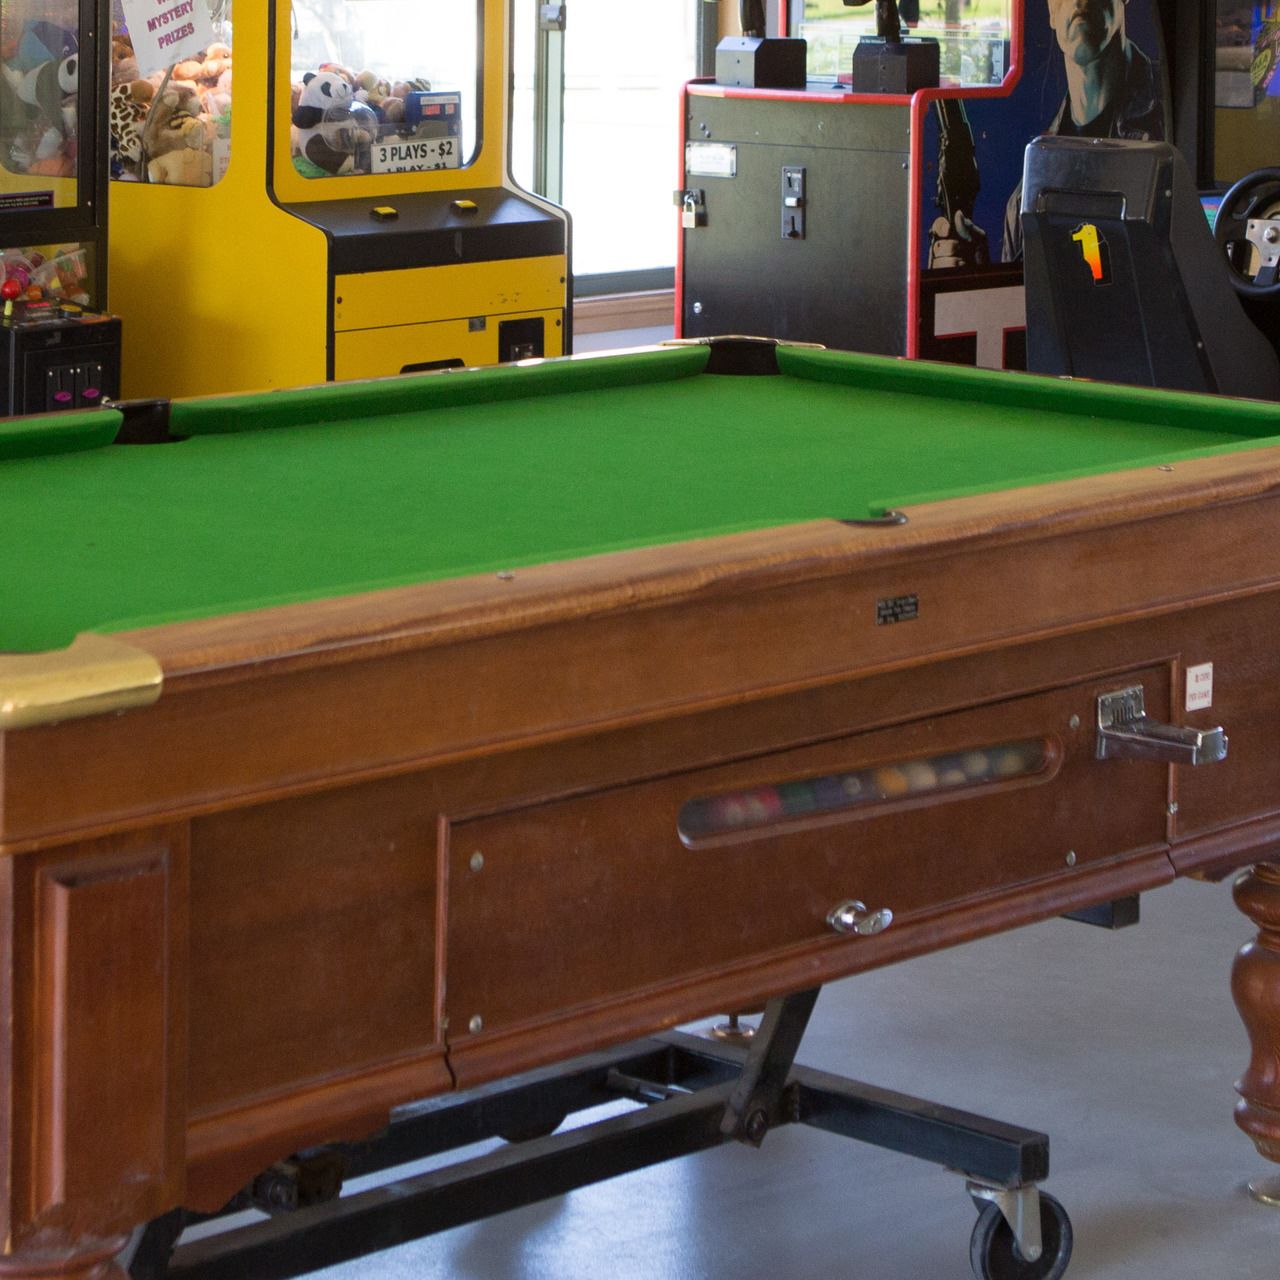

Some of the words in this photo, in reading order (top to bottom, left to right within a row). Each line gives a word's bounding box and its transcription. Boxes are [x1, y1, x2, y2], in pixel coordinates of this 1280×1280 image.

[158, 22, 195, 49] PRIZES
[380, 147, 387, 163] 3
[390, 143, 427, 162] PLAYS
[438, 140, 453, 159] $2
[1071, 223, 1104, 280] 1
